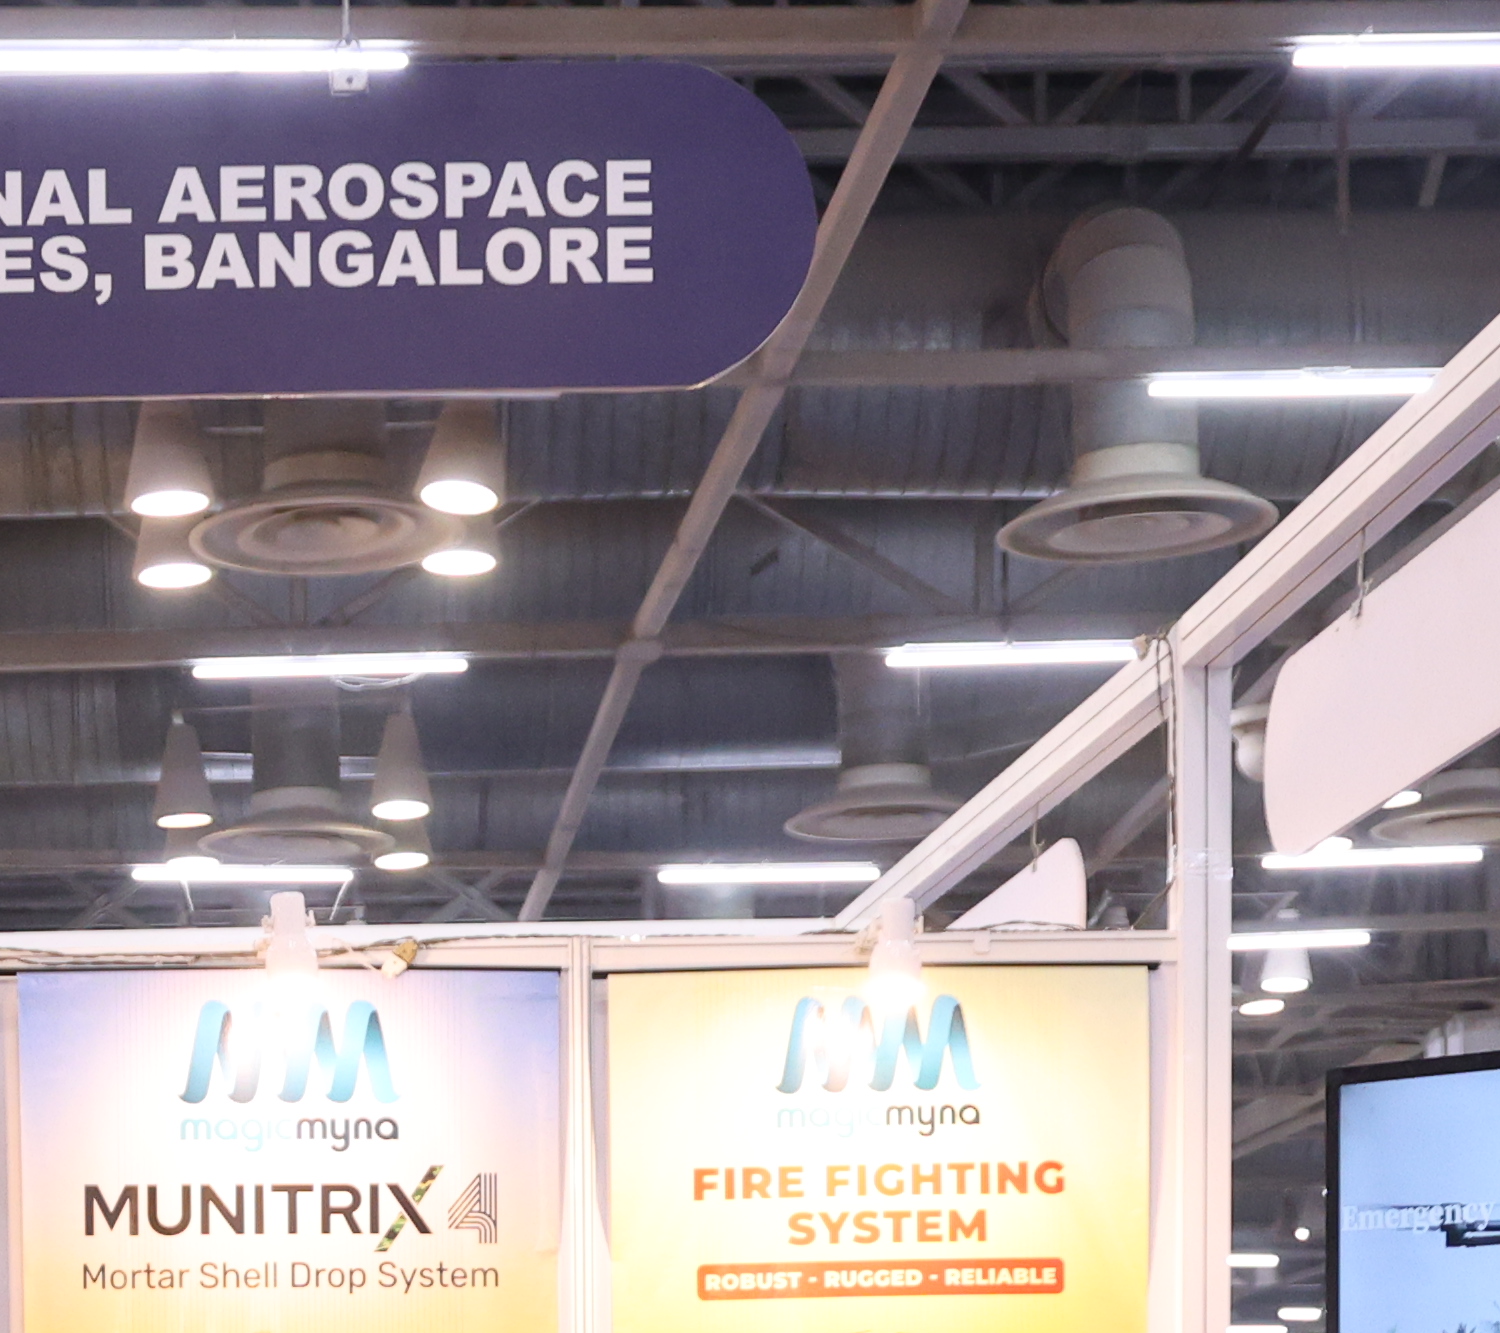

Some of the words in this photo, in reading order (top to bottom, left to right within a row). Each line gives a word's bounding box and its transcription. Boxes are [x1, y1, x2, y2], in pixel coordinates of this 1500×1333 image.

[157, 160, 653, 224] AEROSPACE
[143, 226, 655, 292] BANGALORE
[693, 1165, 806, 1201] FIRE
[825, 1161, 1066, 1197] FIGHTING
[83, 1165, 445, 1252] MUNITRIX
[787, 1208, 988, 1247] SYSTEM
[1341, 1198, 1495, 1232] Emergency
[82, 1261, 191, 1290] Mortar
[199, 1261, 278, 1289] Shell
[290, 1262, 367, 1294] Drop
[378, 1262, 499, 1294] System
[704, 1270, 802, 1292] ROBUST
[824, 1268, 923, 1289] RUGGED
[944, 1266, 1057, 1286] RELIABLE
